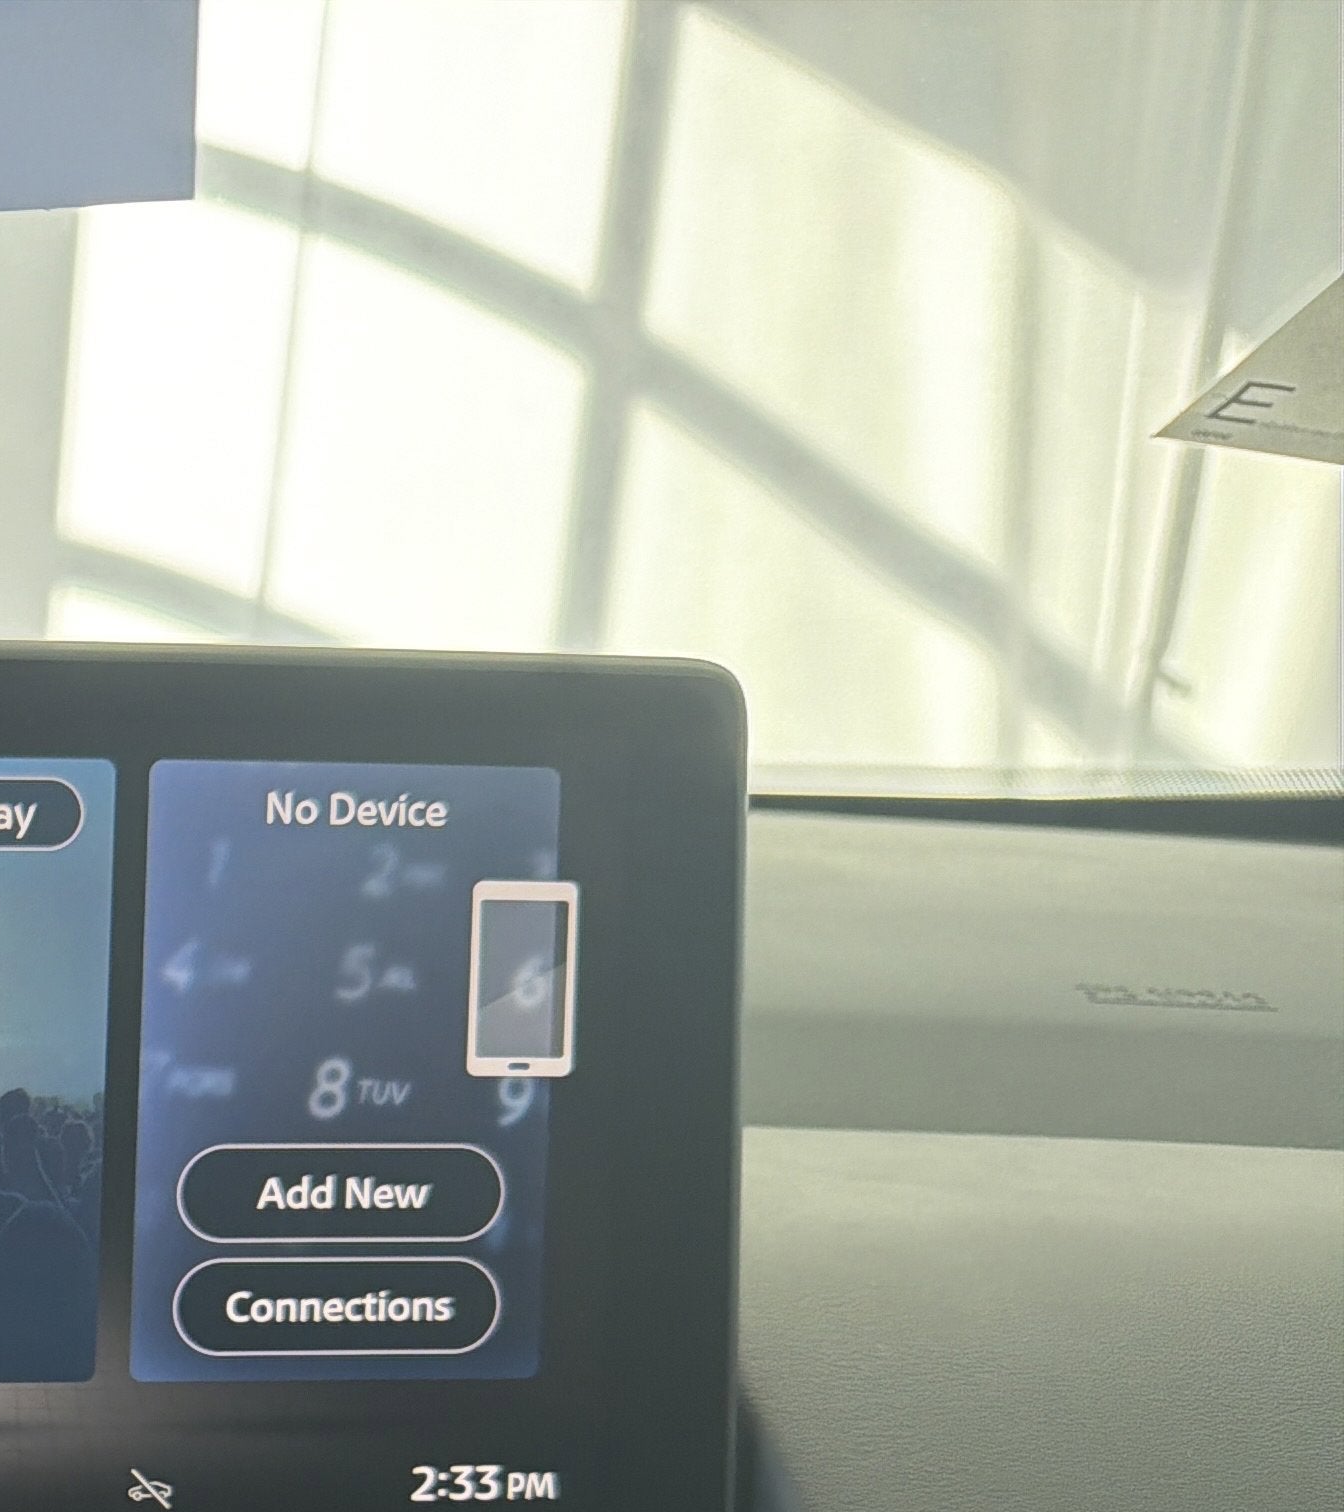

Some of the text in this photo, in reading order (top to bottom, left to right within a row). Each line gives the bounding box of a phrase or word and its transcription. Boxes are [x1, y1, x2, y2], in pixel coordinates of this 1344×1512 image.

[266, 790, 449, 827] No Device
[309, 1057, 352, 1119] 8
[256, 1174, 433, 1210] Add New
[226, 1289, 457, 1323] Connections
[410, 1464, 559, 1502] 2:33 PM
